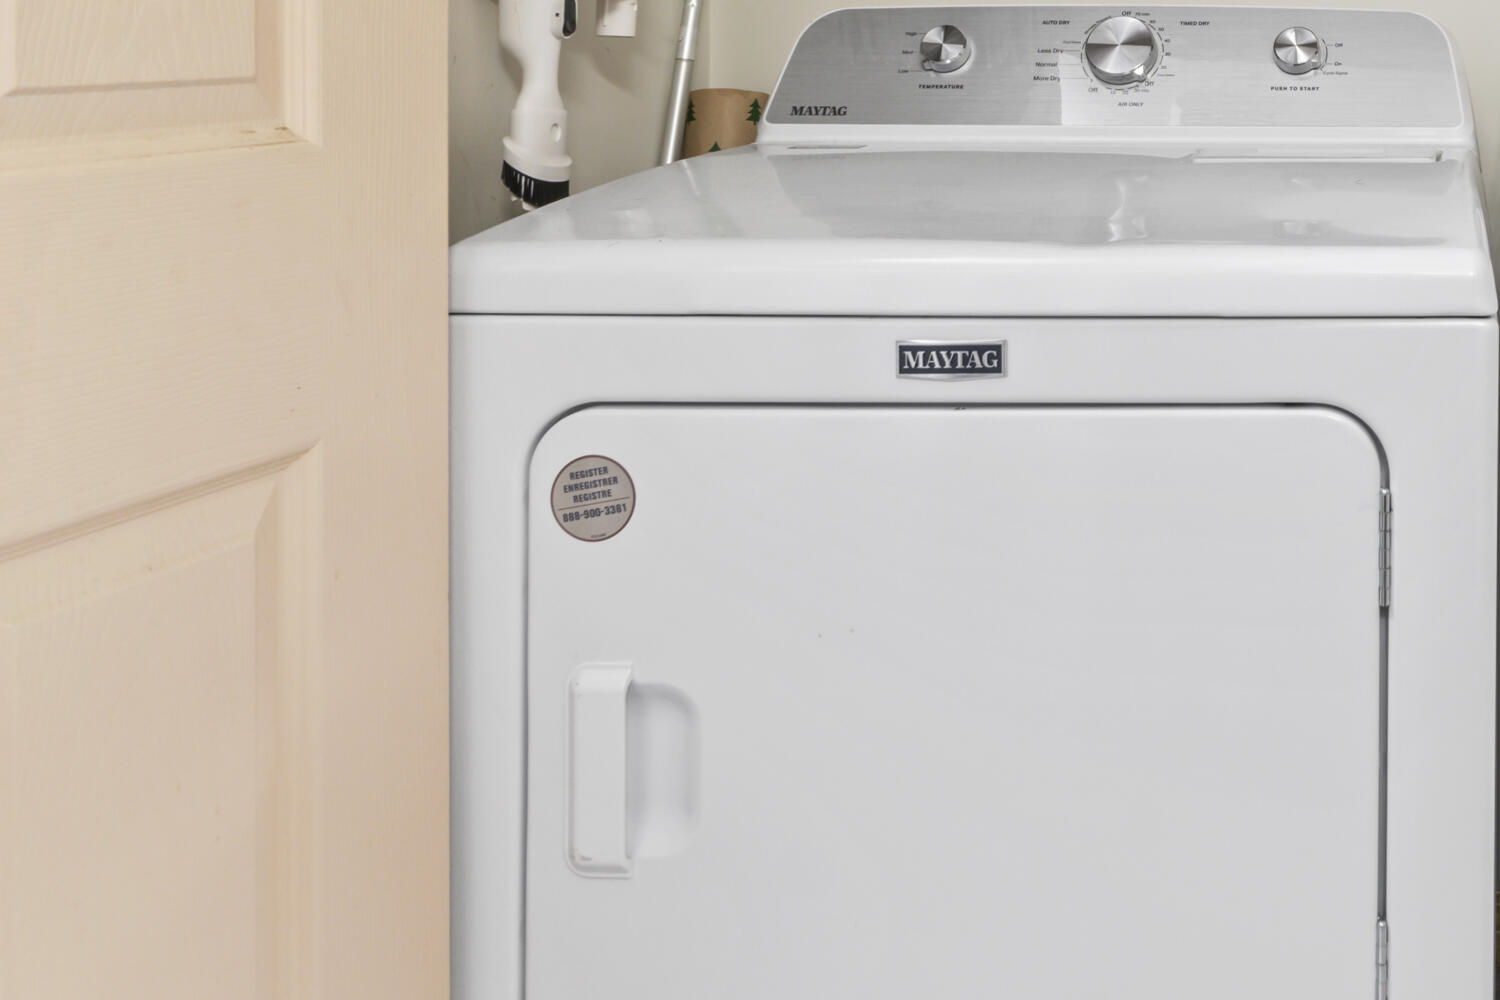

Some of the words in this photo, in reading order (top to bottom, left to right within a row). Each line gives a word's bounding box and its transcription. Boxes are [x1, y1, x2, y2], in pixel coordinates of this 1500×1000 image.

[1053, 48, 1064, 56] Dry
[1050, 75, 1061, 83] Dry
[791, 106, 847, 116] MAYTAG
[903, 350, 999, 369] MAYTAG
[569, 466, 608, 480] REGISTER
[563, 476, 619, 493] ENREGISTRER
[572, 489, 612, 503] REGISTRE
[562, 503, 627, 522] 888-900-3381
